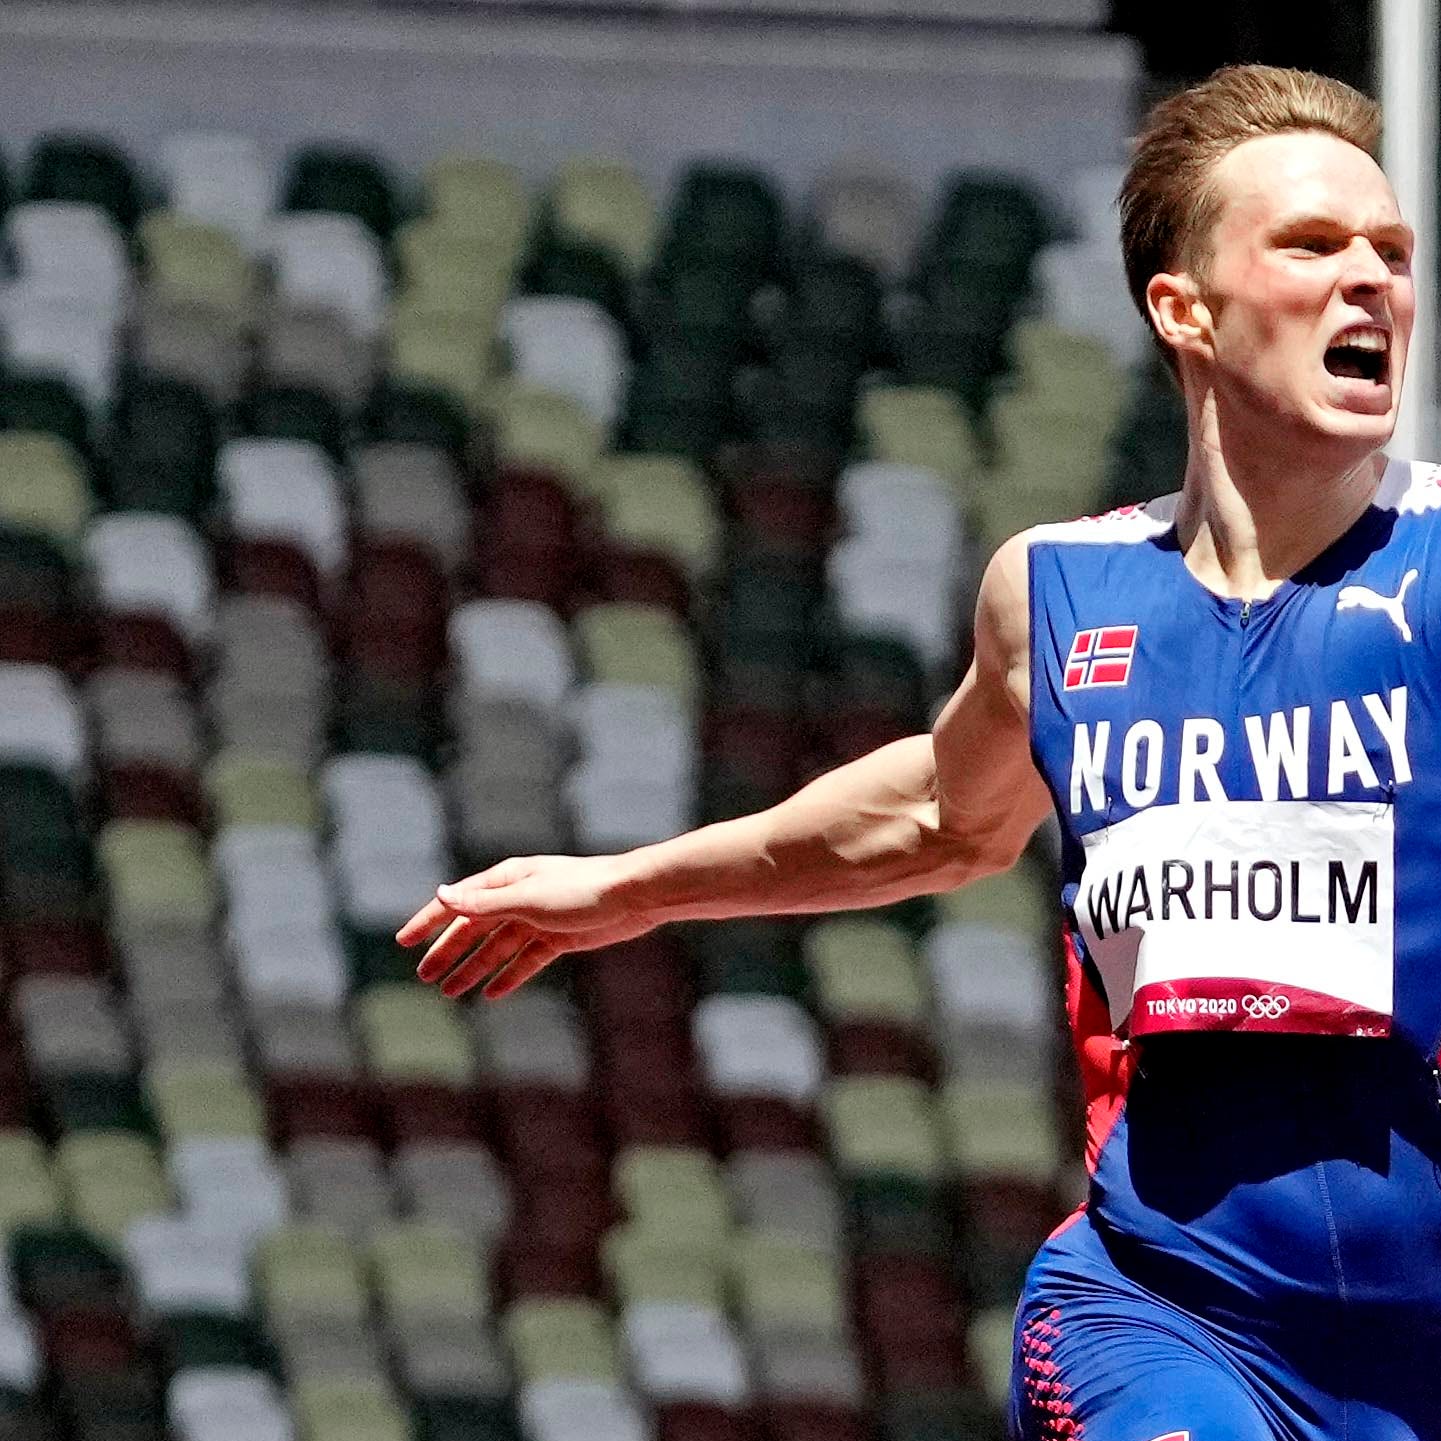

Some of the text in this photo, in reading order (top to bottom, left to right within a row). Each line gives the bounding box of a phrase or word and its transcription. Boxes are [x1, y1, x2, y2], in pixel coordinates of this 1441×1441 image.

[1070, 686, 1413, 814] NORWAY
[1087, 850, 1378, 940] WARHOLM
[1146, 997, 1237, 1016] TOKYO 2020
